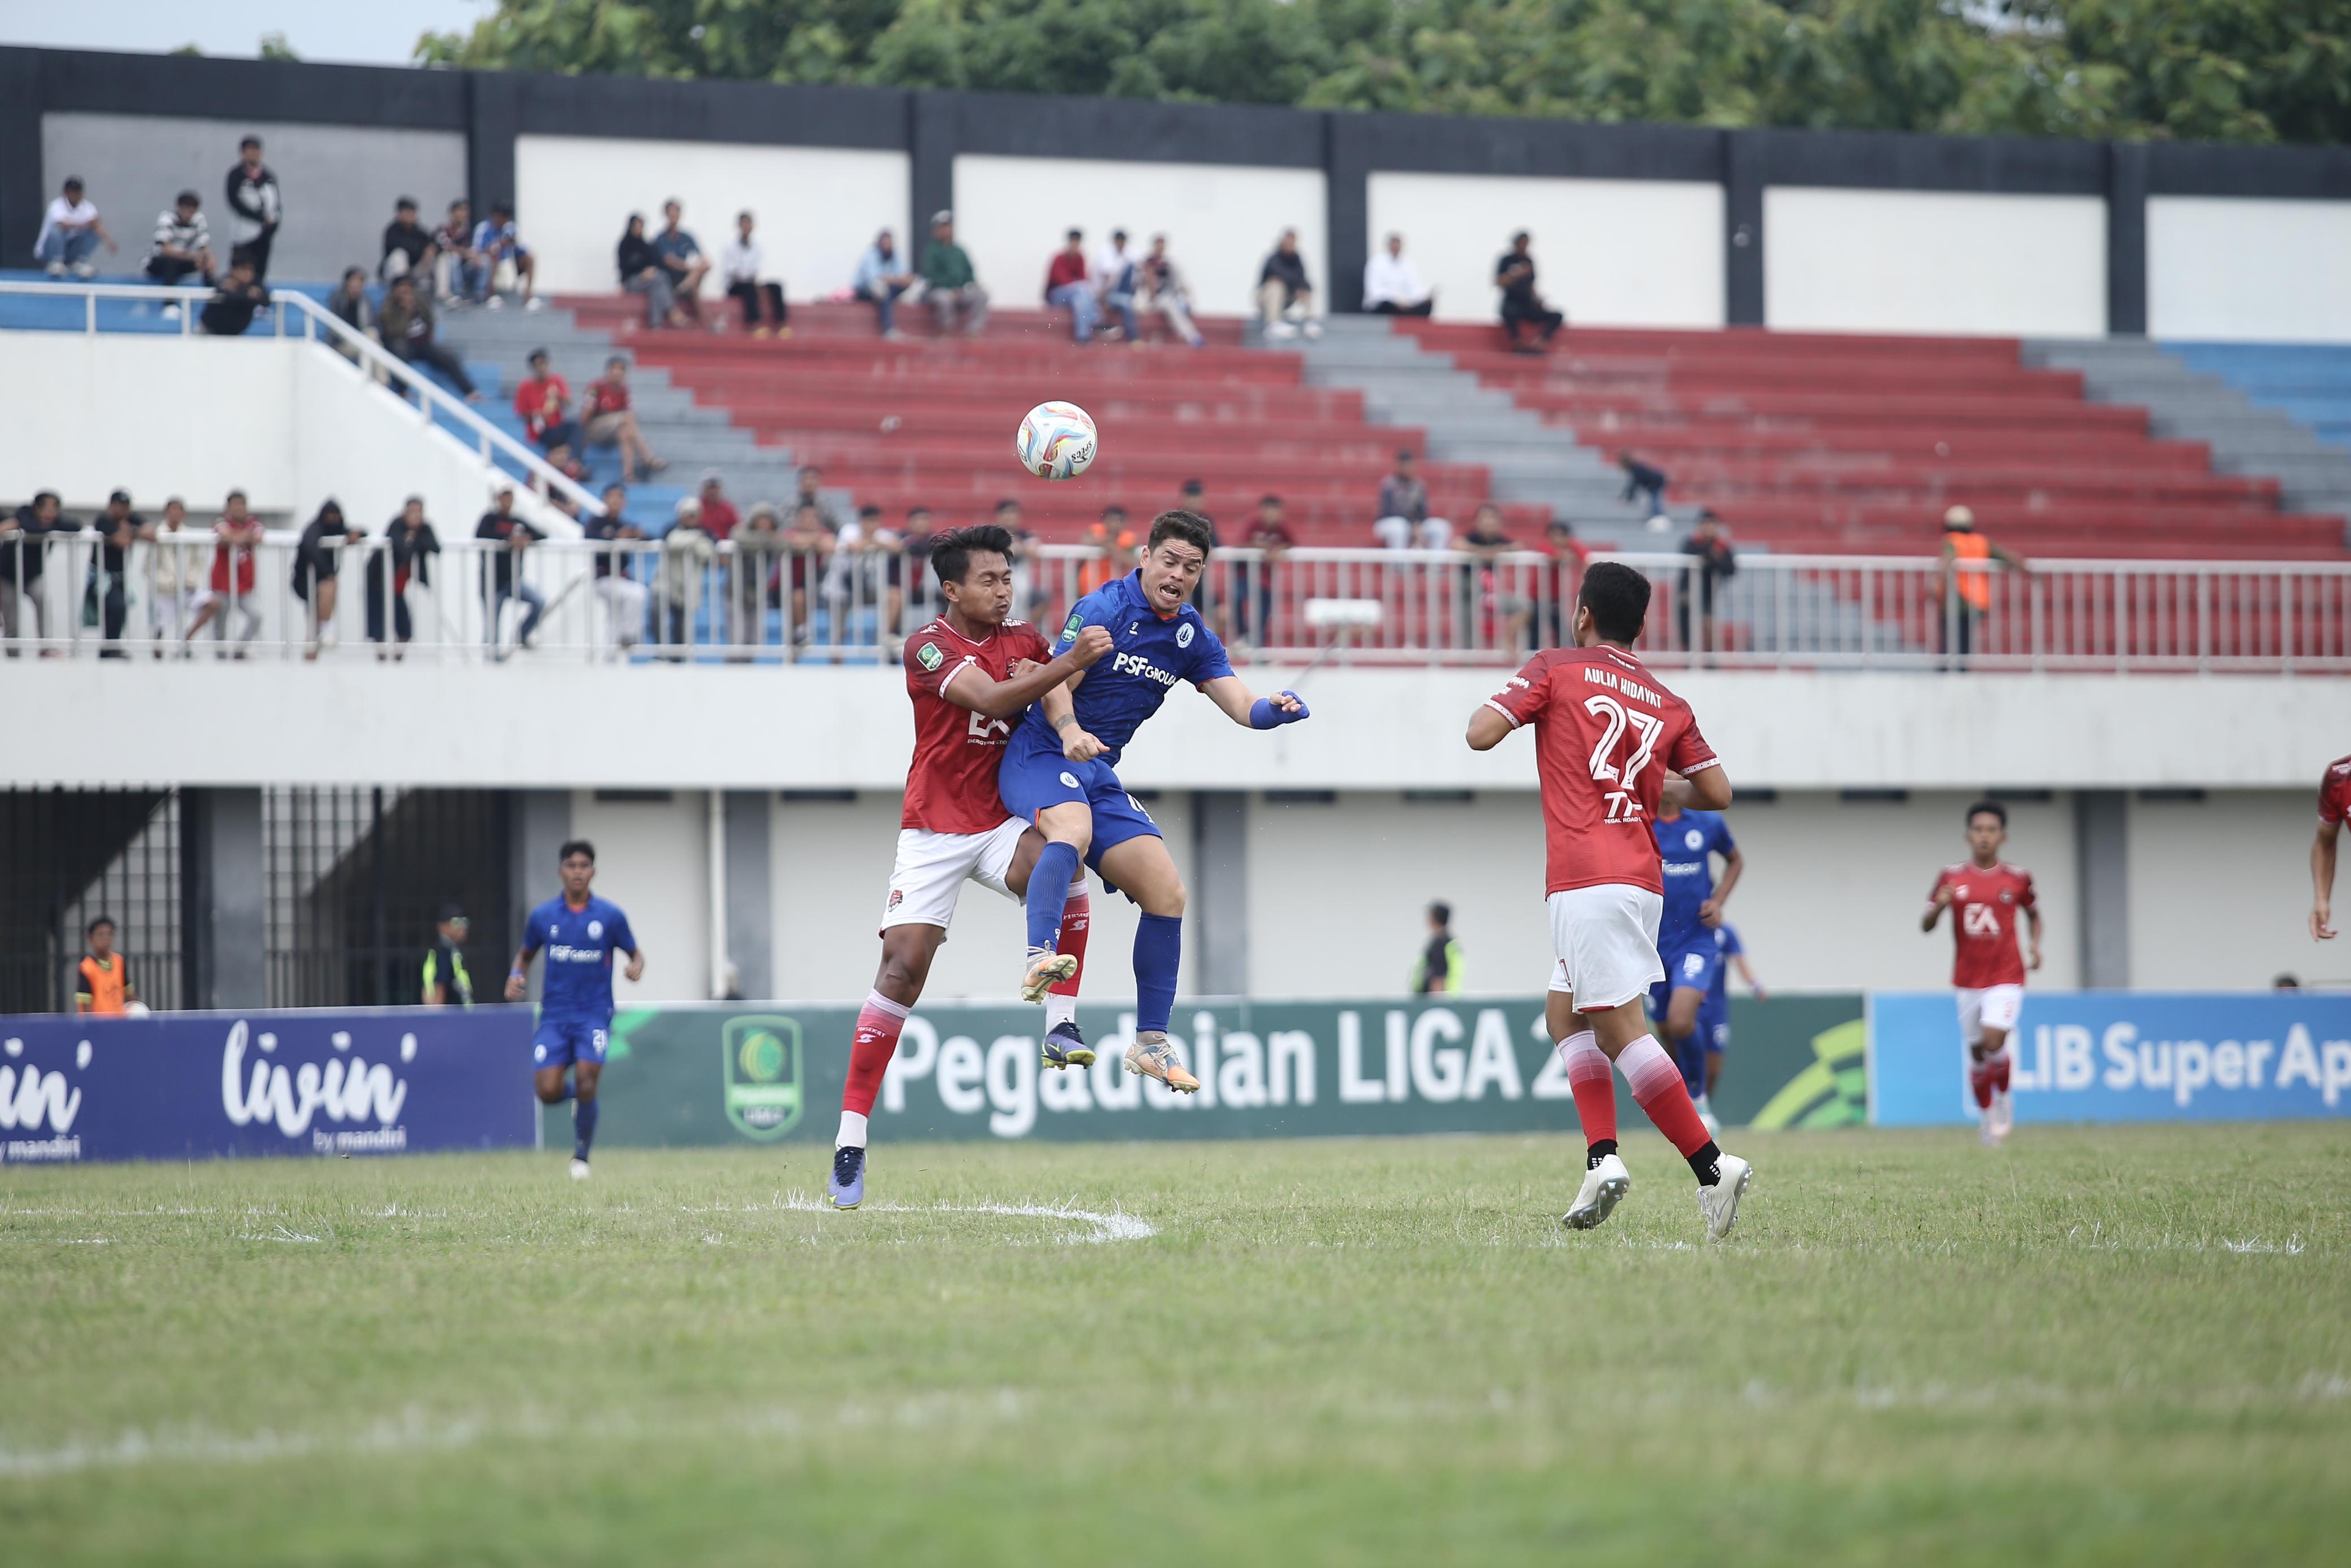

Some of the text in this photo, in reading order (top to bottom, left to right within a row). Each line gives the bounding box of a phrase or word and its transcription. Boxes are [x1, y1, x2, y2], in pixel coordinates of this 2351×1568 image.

[1071, 440, 1092, 461] SPECS
[1584, 667, 1662, 709] AULIA HIDAYAT
[1584, 694, 1665, 790] 27
[1963, 902, 2001, 936] EA
[222, 1019, 418, 1138] livin'
[1338, 1007, 1523, 1102] LIGA
[2009, 1023, 2096, 1090] LIB
[2102, 1021, 2274, 1107] Super
